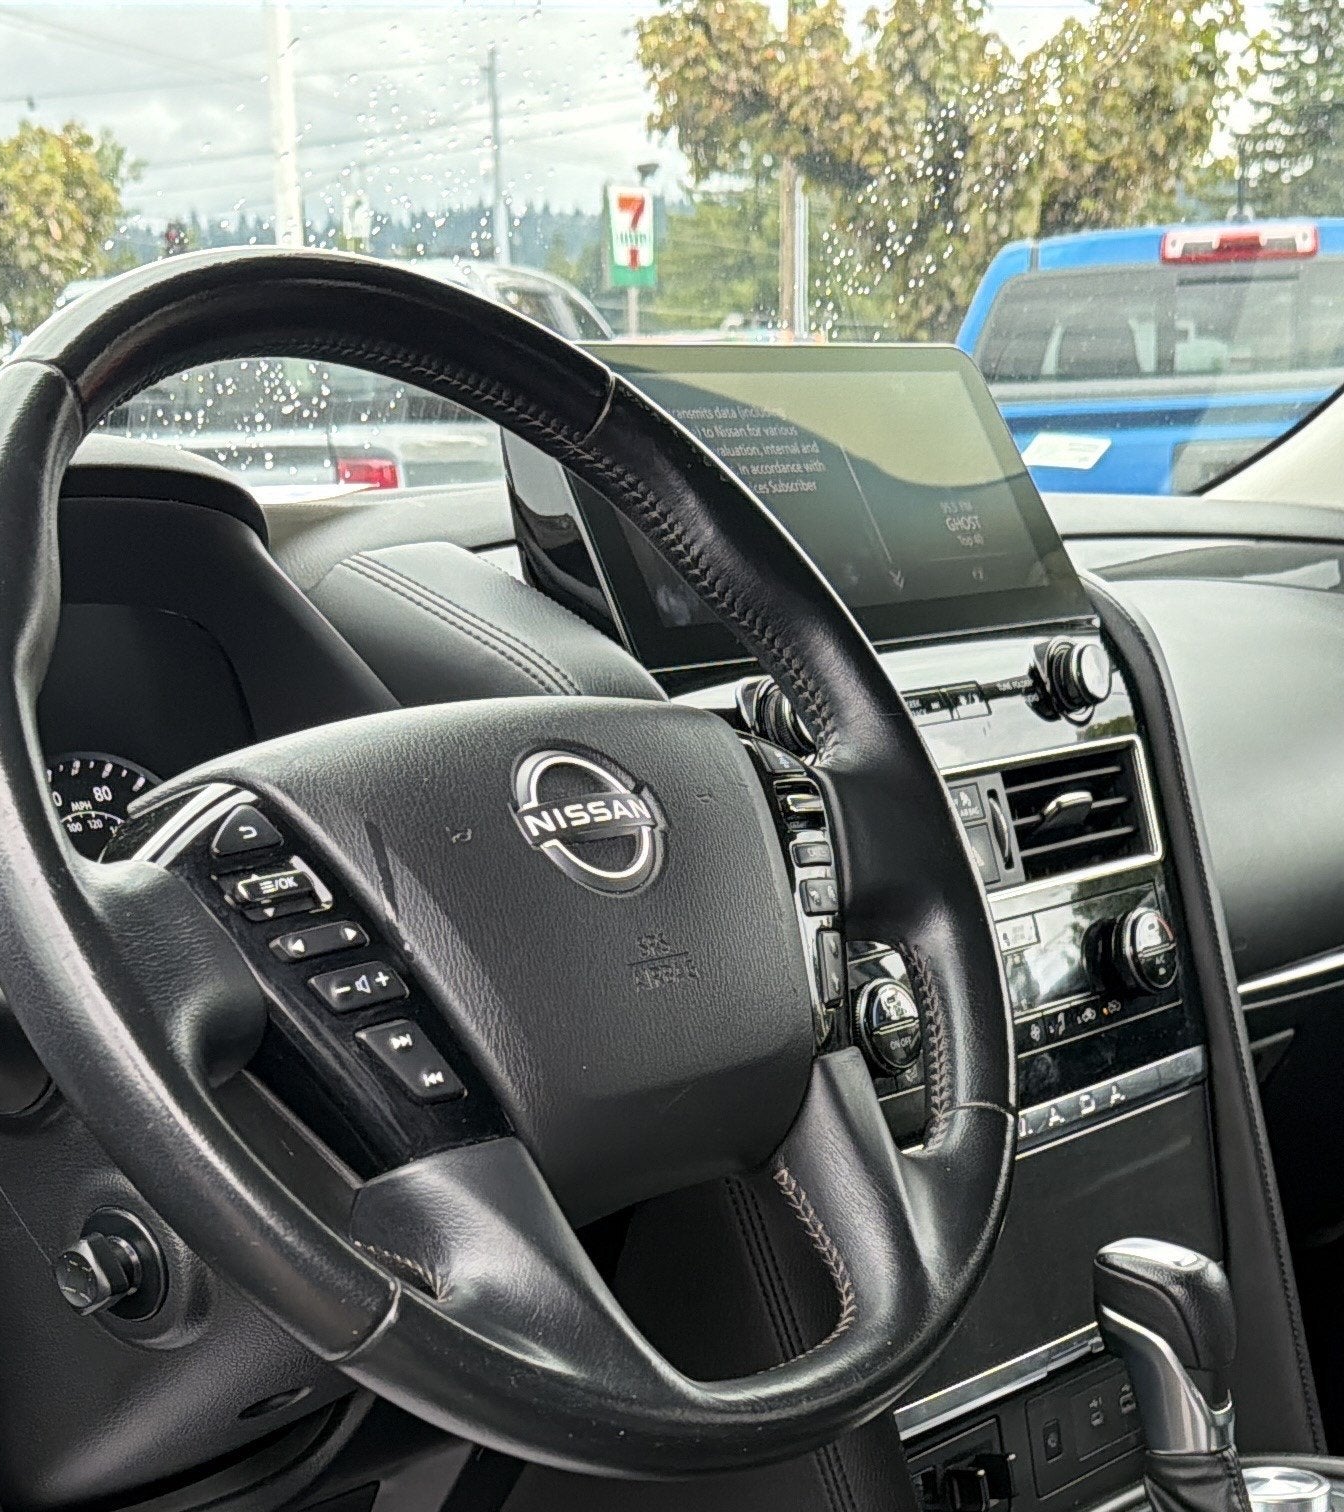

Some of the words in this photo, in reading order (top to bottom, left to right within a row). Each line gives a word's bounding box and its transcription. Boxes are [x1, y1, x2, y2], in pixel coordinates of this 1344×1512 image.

[672, 405, 714, 420] ransmits
[715, 406, 738, 419] data
[702, 427, 715, 438] to
[715, 425, 748, 438] Nissan
[747, 424, 762, 438] for
[762, 425, 798, 437] various
[762, 441, 801, 454] internal
[801, 440, 820, 454] and
[750, 460, 804, 475] accordance
[768, 478, 817, 494] Subscriber
[945, 516, 982, 531] GHOST
[52, 791, 63, 807] 0
[93, 785, 113, 802] 80
[70, 800, 93, 812] MPH
[523, 799, 651, 837] NISSAN
